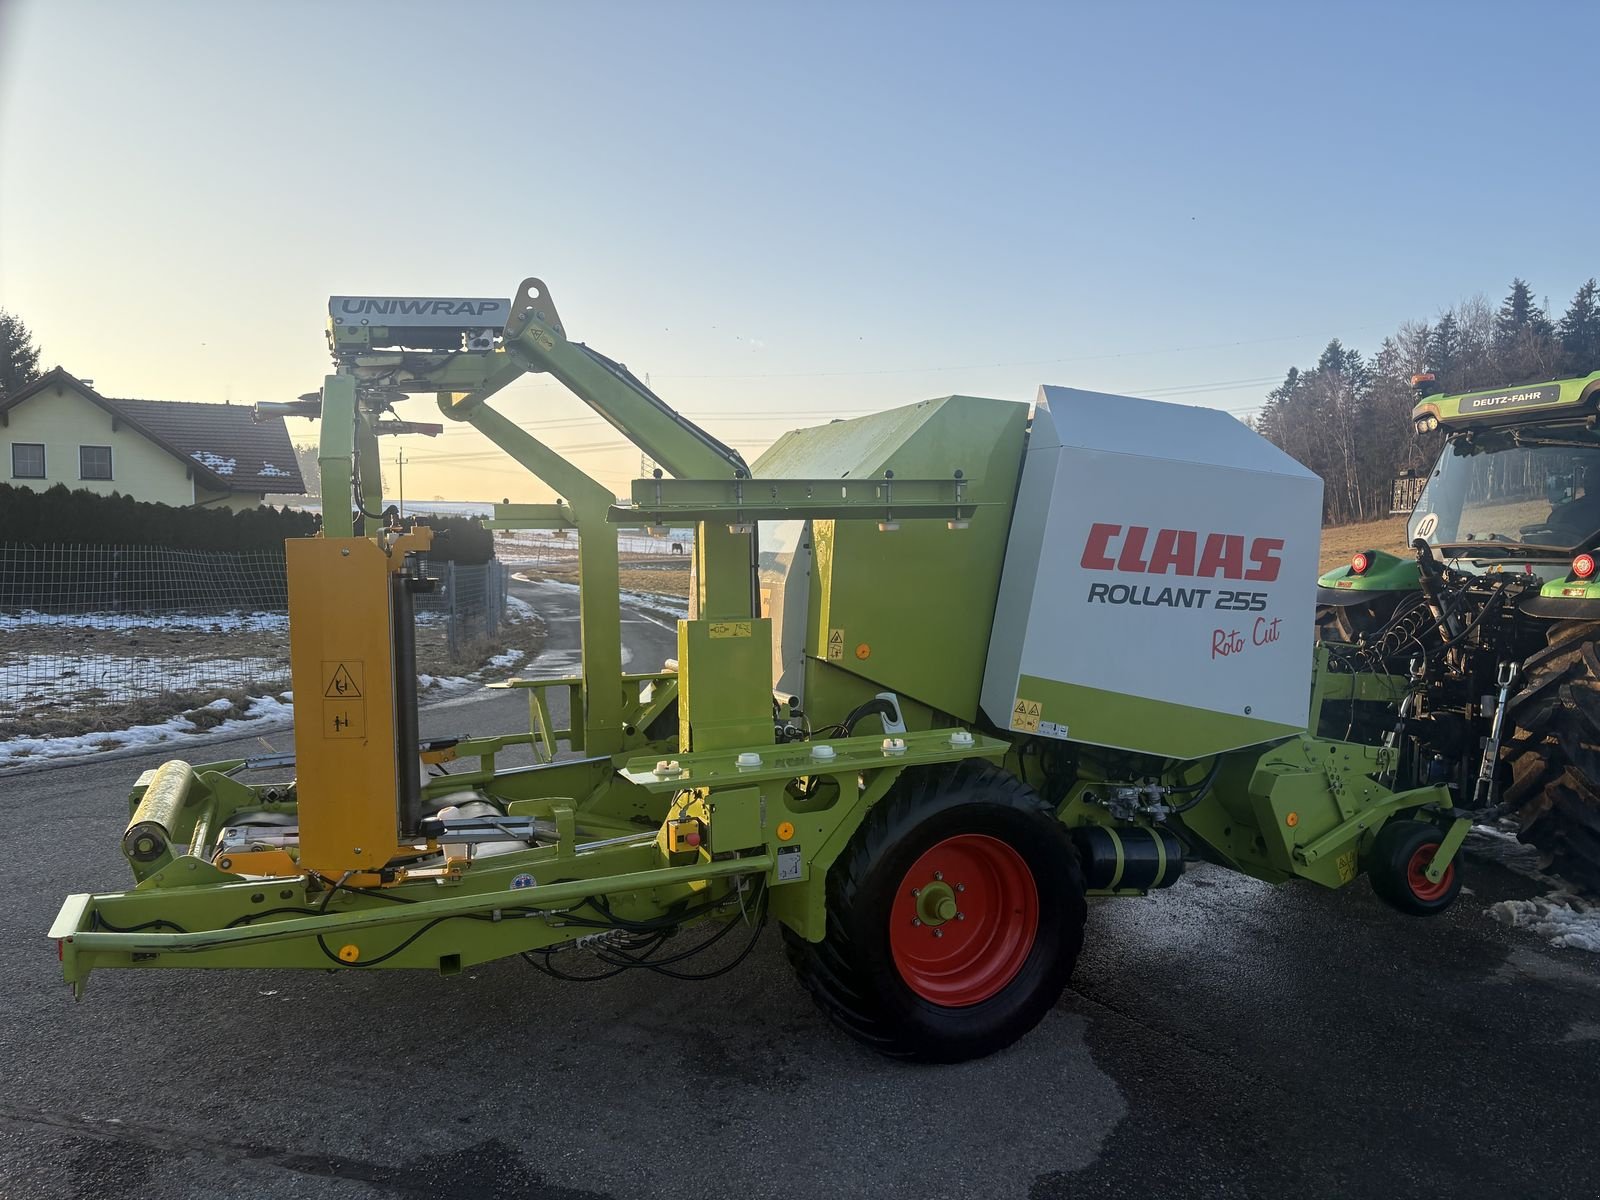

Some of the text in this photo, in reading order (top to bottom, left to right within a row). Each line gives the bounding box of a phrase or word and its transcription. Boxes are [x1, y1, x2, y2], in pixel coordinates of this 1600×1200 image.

[342, 300, 499, 315] UNIWRAP
[1473, 391, 1541, 407] DEUTZ-FAHR
[1417, 519, 1434, 537] 40
[1080, 523, 1285, 582] CLAAS
[1087, 583, 1268, 611] ROLLANT 255
[1211, 617, 1282, 660] Roto Cut
